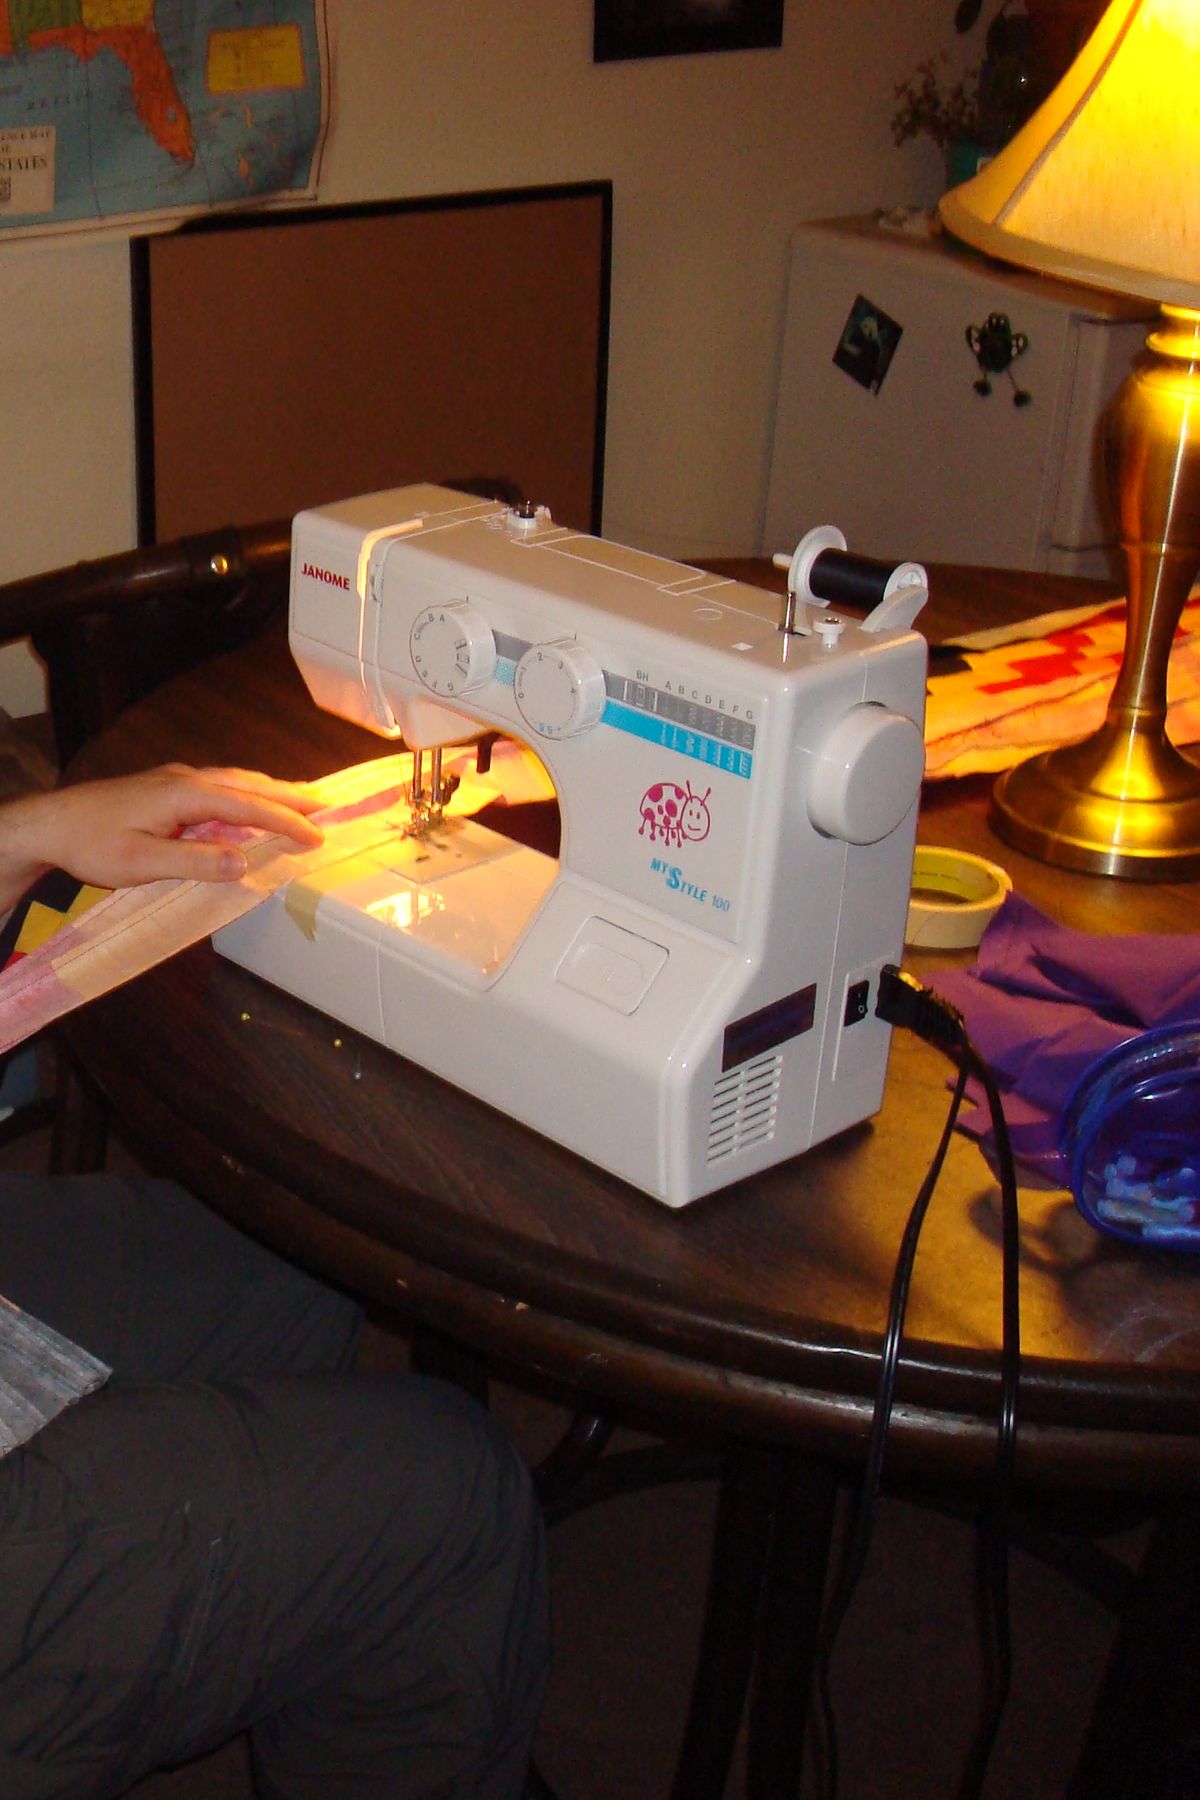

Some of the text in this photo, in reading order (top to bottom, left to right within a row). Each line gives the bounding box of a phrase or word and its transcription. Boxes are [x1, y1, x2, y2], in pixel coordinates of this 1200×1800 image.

[29, 130, 51, 140] MAP
[301, 562, 350, 591] JANOME
[439, 613, 446, 623] A
[536, 651, 543, 662] 2
[636, 669, 753, 720] BH A B C D E F G
[650, 857, 730, 913] MY STYLE 100
